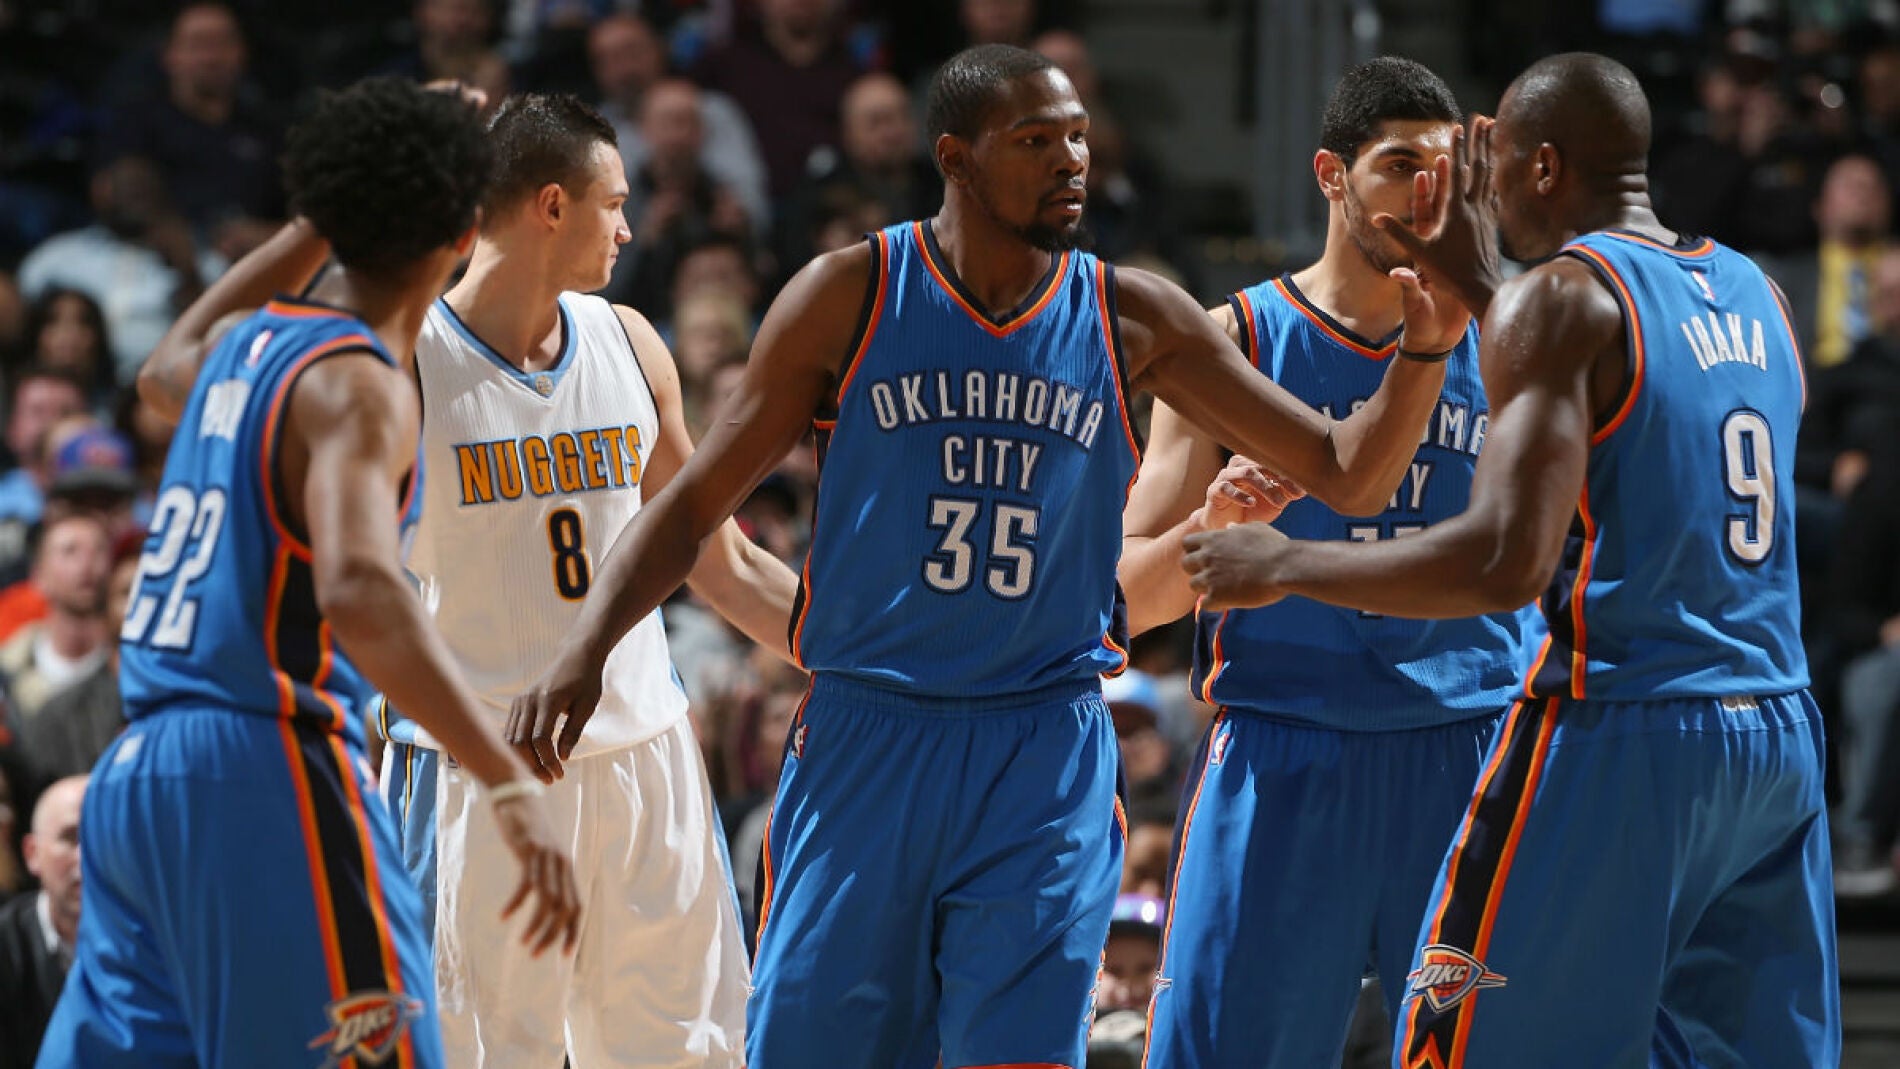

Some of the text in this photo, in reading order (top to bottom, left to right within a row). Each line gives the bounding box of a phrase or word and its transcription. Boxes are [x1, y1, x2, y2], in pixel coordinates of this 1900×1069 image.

[1681, 311, 1767, 371] IBAKA
[869, 368, 1106, 452] OKLAHOMA
[455, 423, 643, 505] NUGGETS
[943, 434, 1040, 492] CITY
[1721, 409, 1776, 564] 9
[120, 484, 226, 651] 22
[546, 507, 592, 602] 8
[923, 496, 1040, 599] 35
[1413, 964, 1469, 990] OKC
